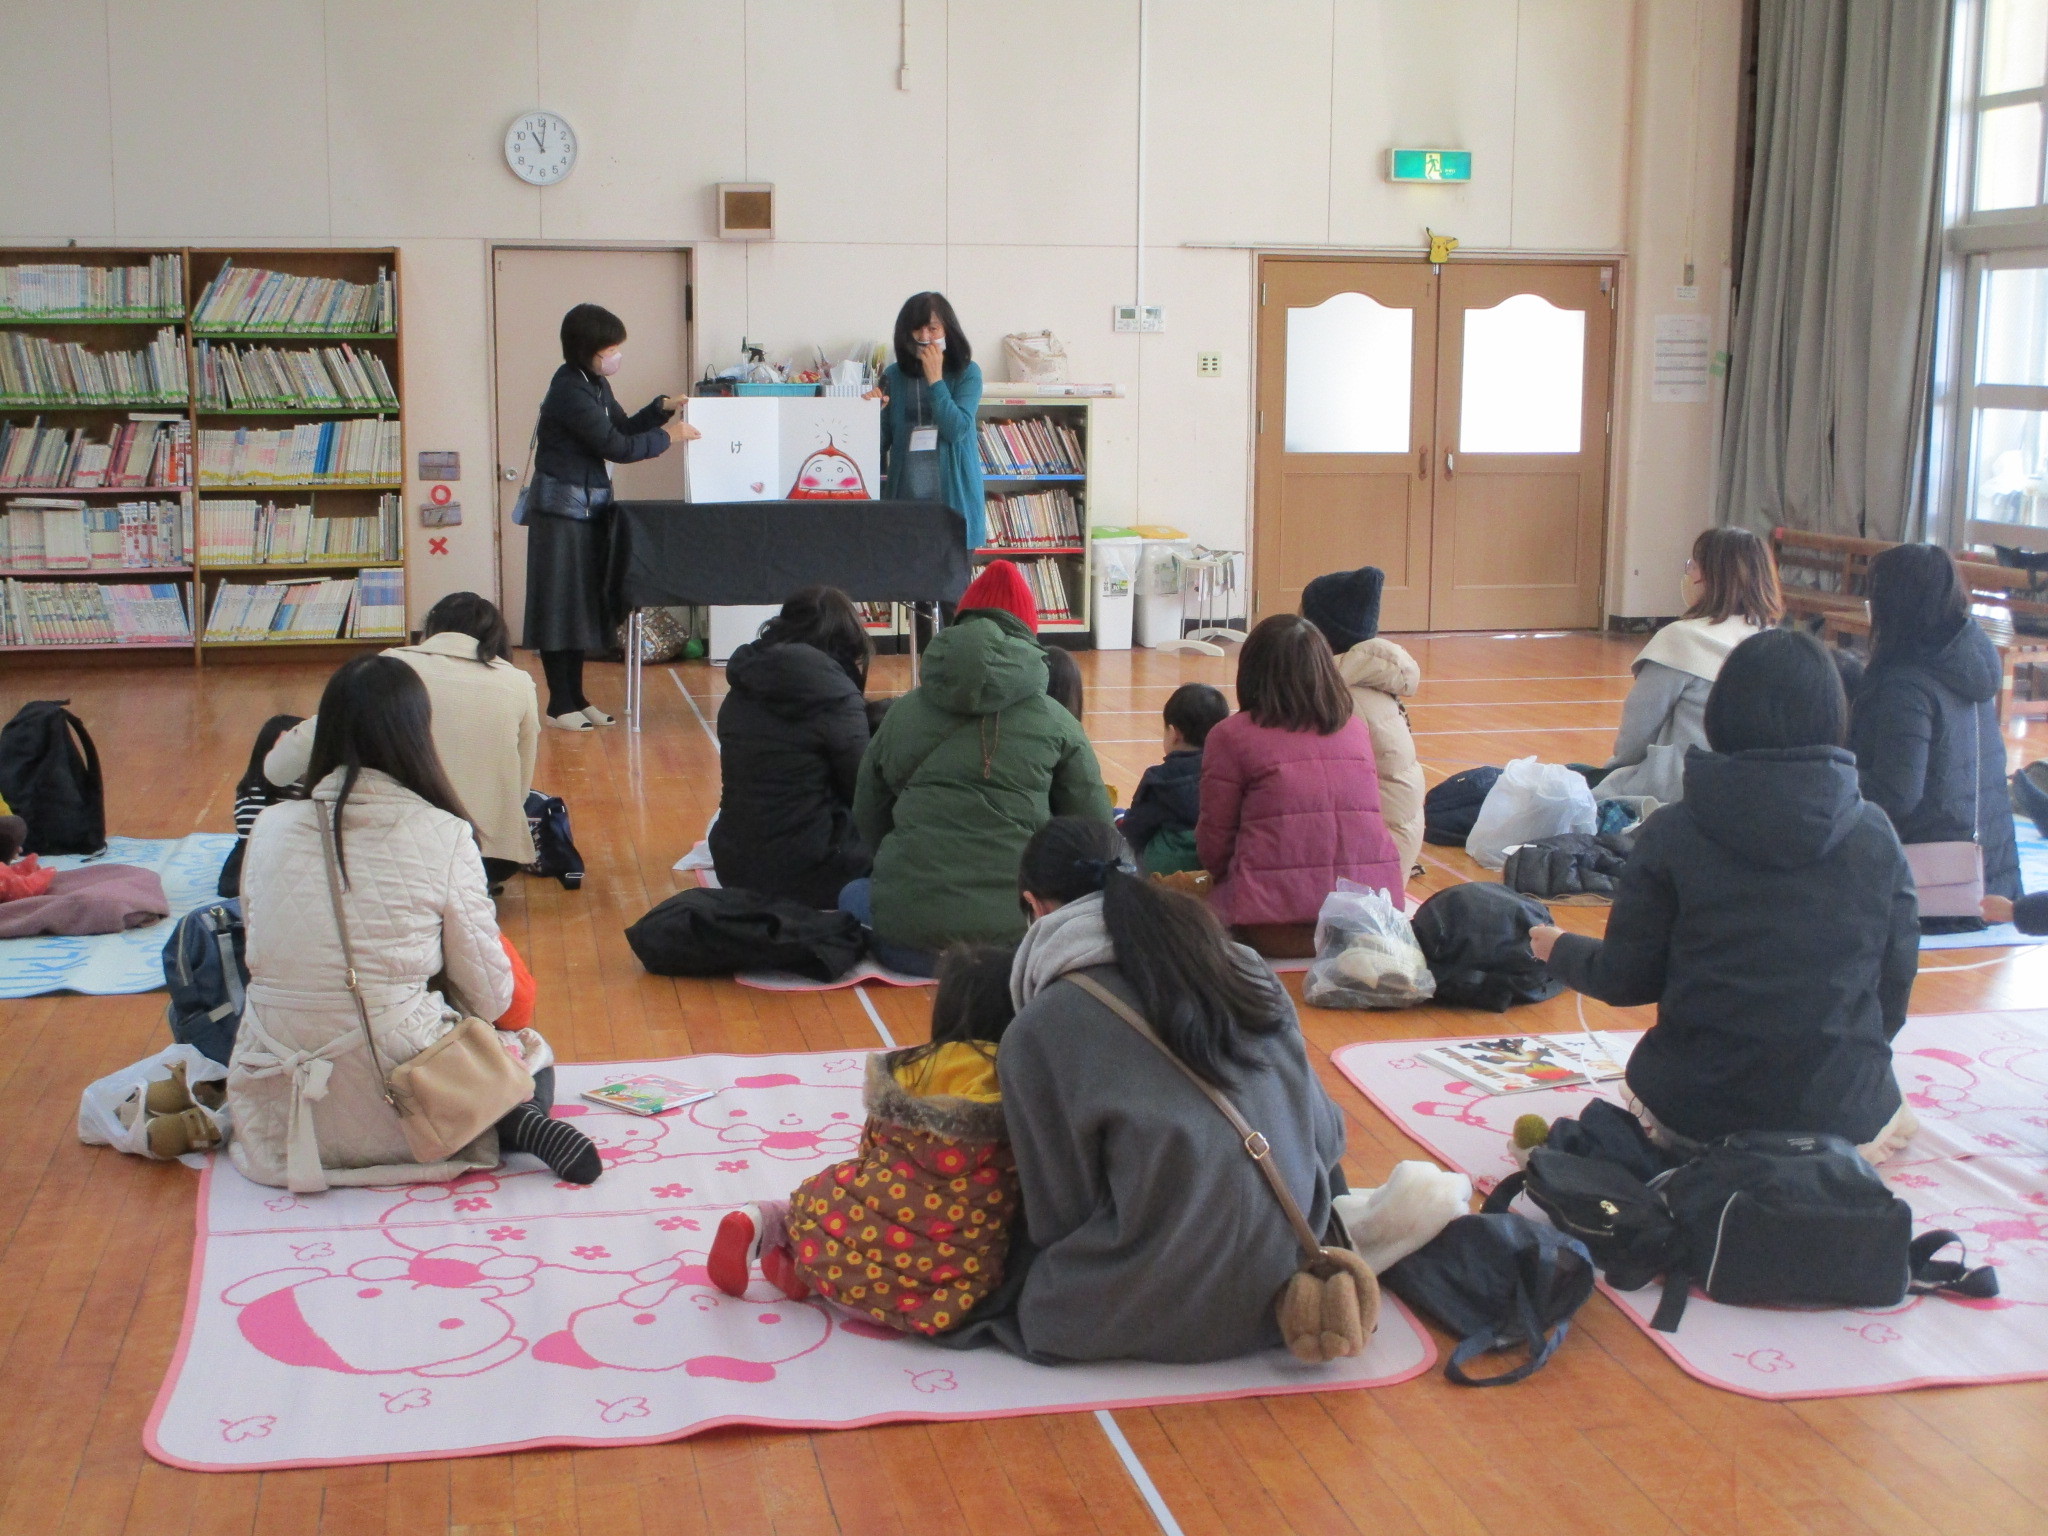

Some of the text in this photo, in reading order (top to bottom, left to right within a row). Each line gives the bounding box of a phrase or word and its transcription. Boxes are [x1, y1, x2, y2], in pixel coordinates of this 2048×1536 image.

[525, 121, 533, 131] 11
[516, 131, 526, 140] 10
[560, 131, 567, 140] 2
[513, 144, 521, 153] 9
[564, 144, 571, 153] 3
[518, 156, 525, 165] 8
[560, 156, 567, 165] 4
[528, 165, 534, 174] 7
[539, 168, 546, 177] 6
[552, 165, 559, 174] 5
[730, 440, 743, 454] け
